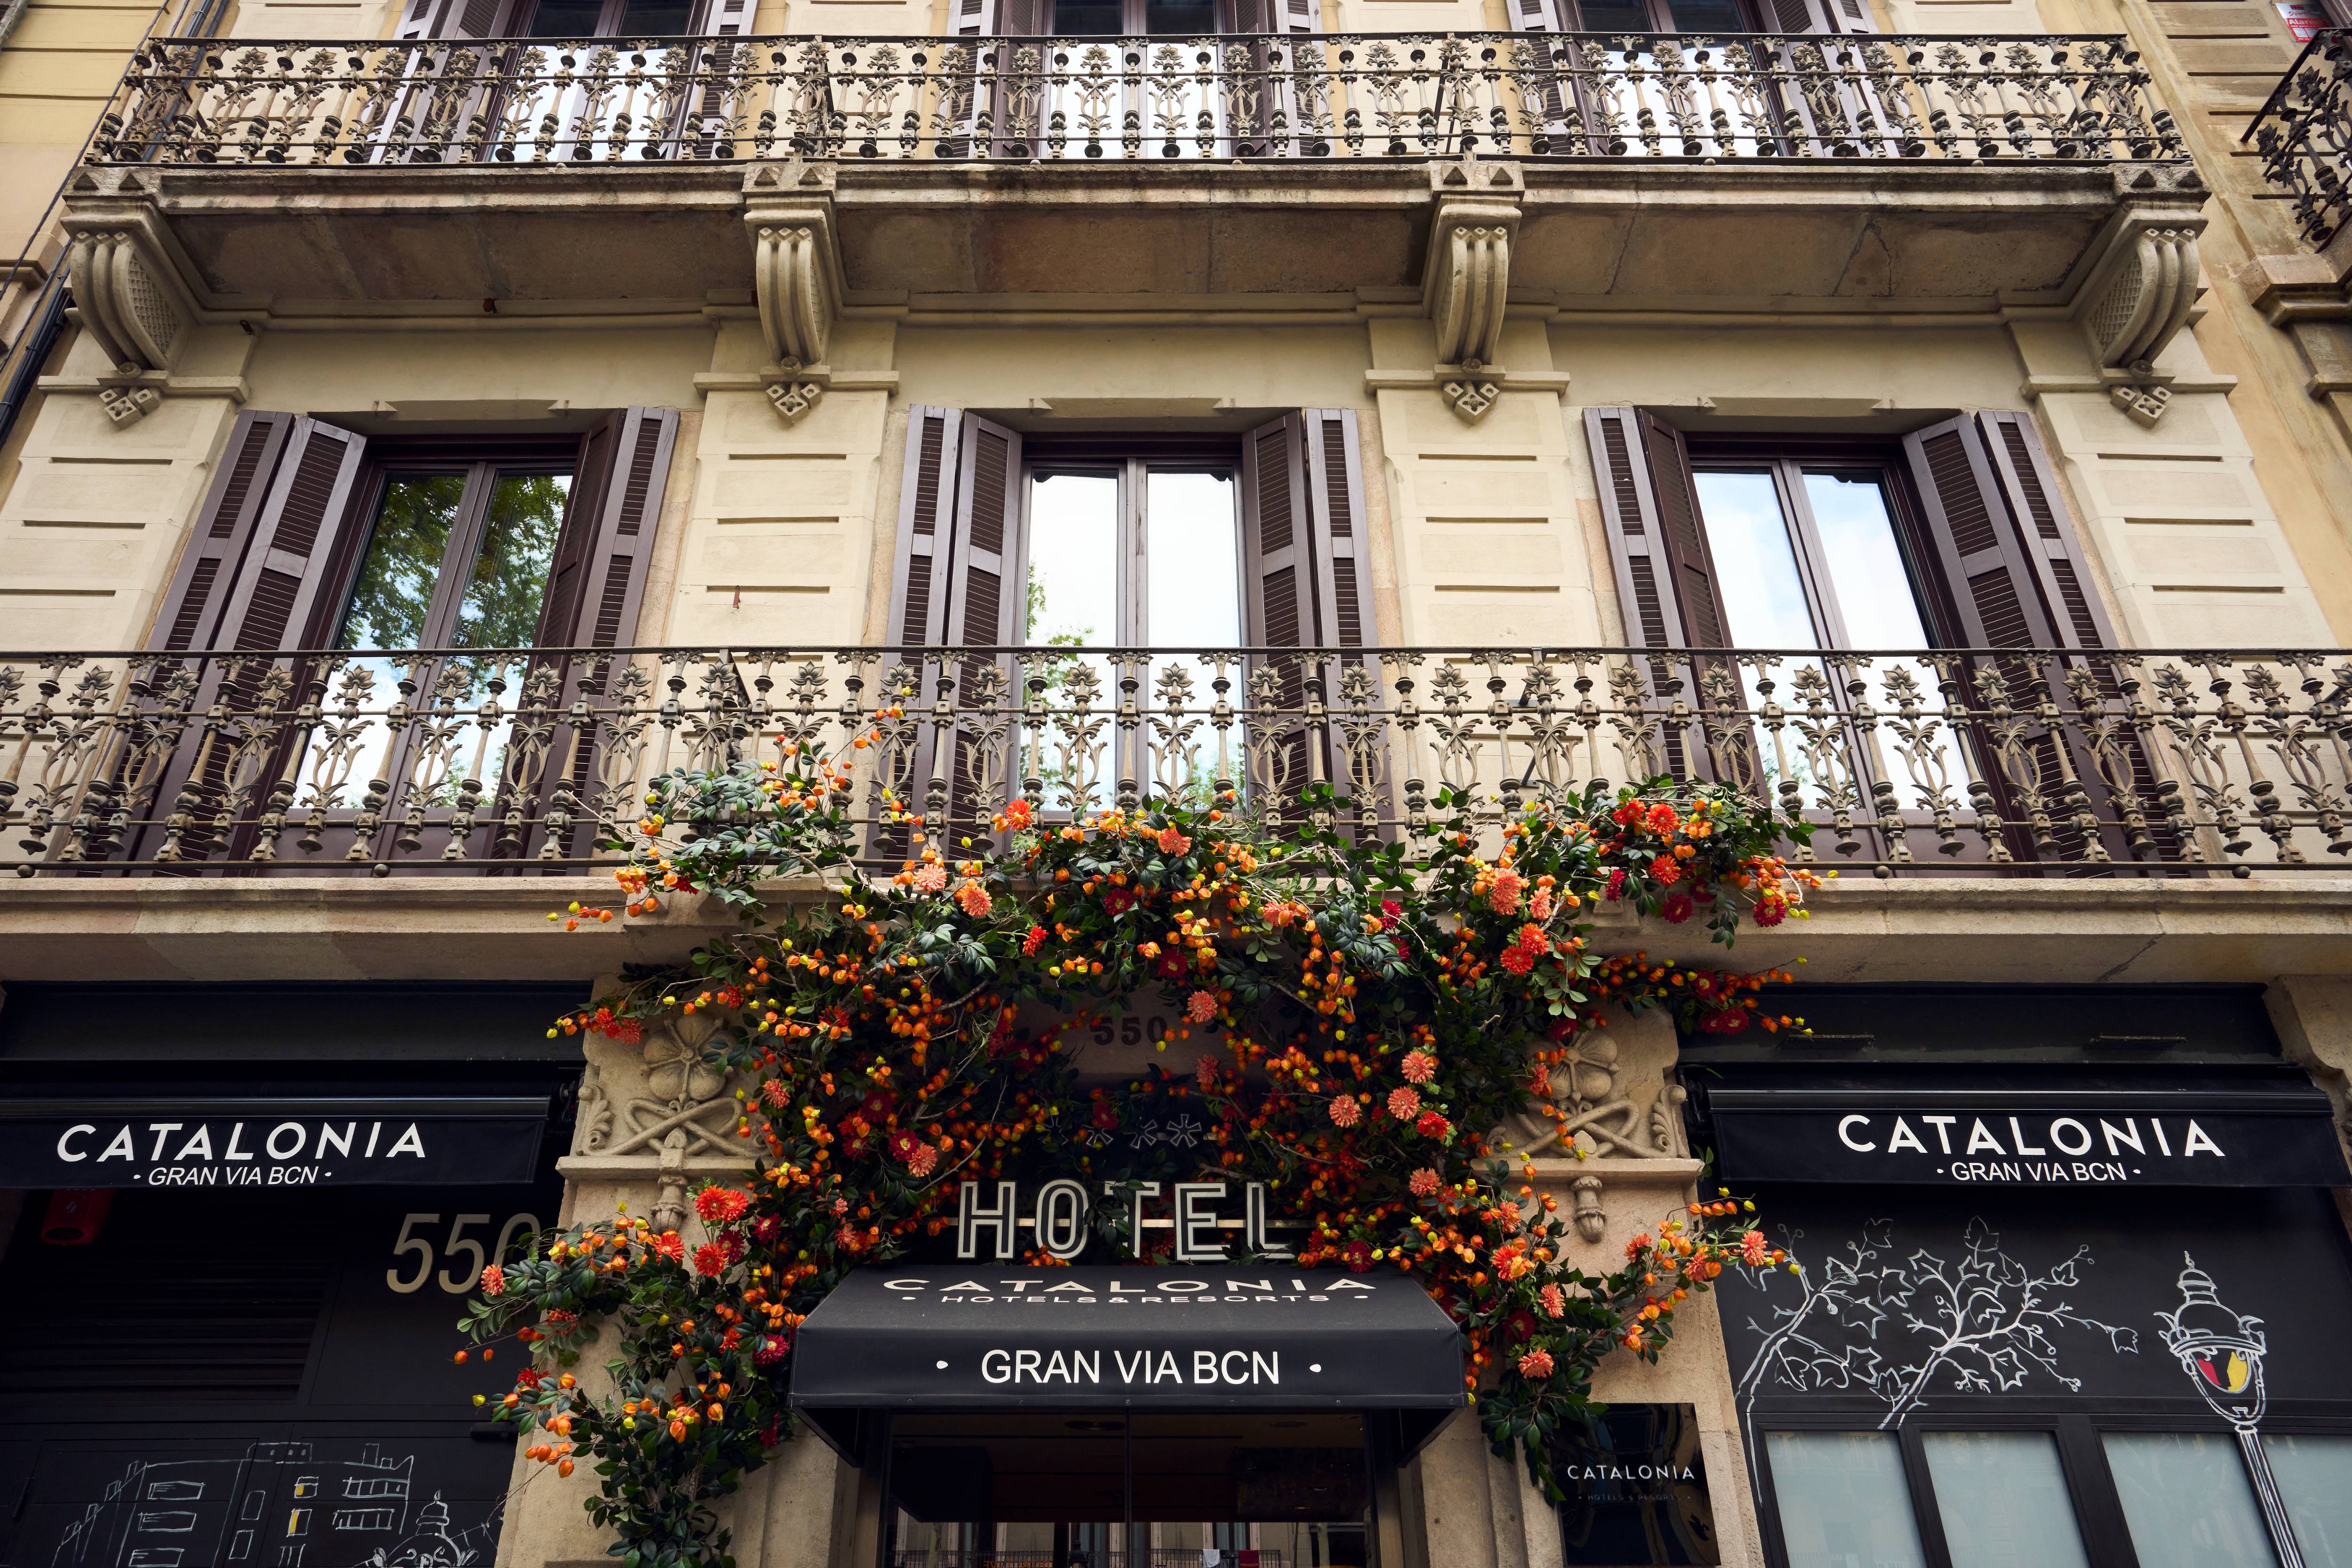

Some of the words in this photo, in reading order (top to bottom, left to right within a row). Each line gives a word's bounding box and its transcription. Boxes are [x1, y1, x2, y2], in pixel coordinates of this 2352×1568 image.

[1089, 1016, 1168, 1045] 550
[57, 1122, 426, 1162] CATALONIA
[1838, 1114, 2225, 1157] CATALONIA
[148, 1167, 219, 1186] GRAN
[226, 1167, 262, 1185] VIA
[267, 1166, 319, 1185] BCN
[1951, 1162, 2021, 1181] GRAN
[2025, 1162, 2070, 1181] VIA
[2071, 1162, 2127, 1181] BCN
[956, 1178, 1298, 1261] HOTEL
[883, 1277, 1376, 1293] CATALONIA
[981, 1349, 1100, 1384] GRAN
[1114, 1350, 1183, 1384] VIA
[1194, 1351, 1279, 1385] BCN
[1567, 1465, 1694, 1480] CATALONIA
